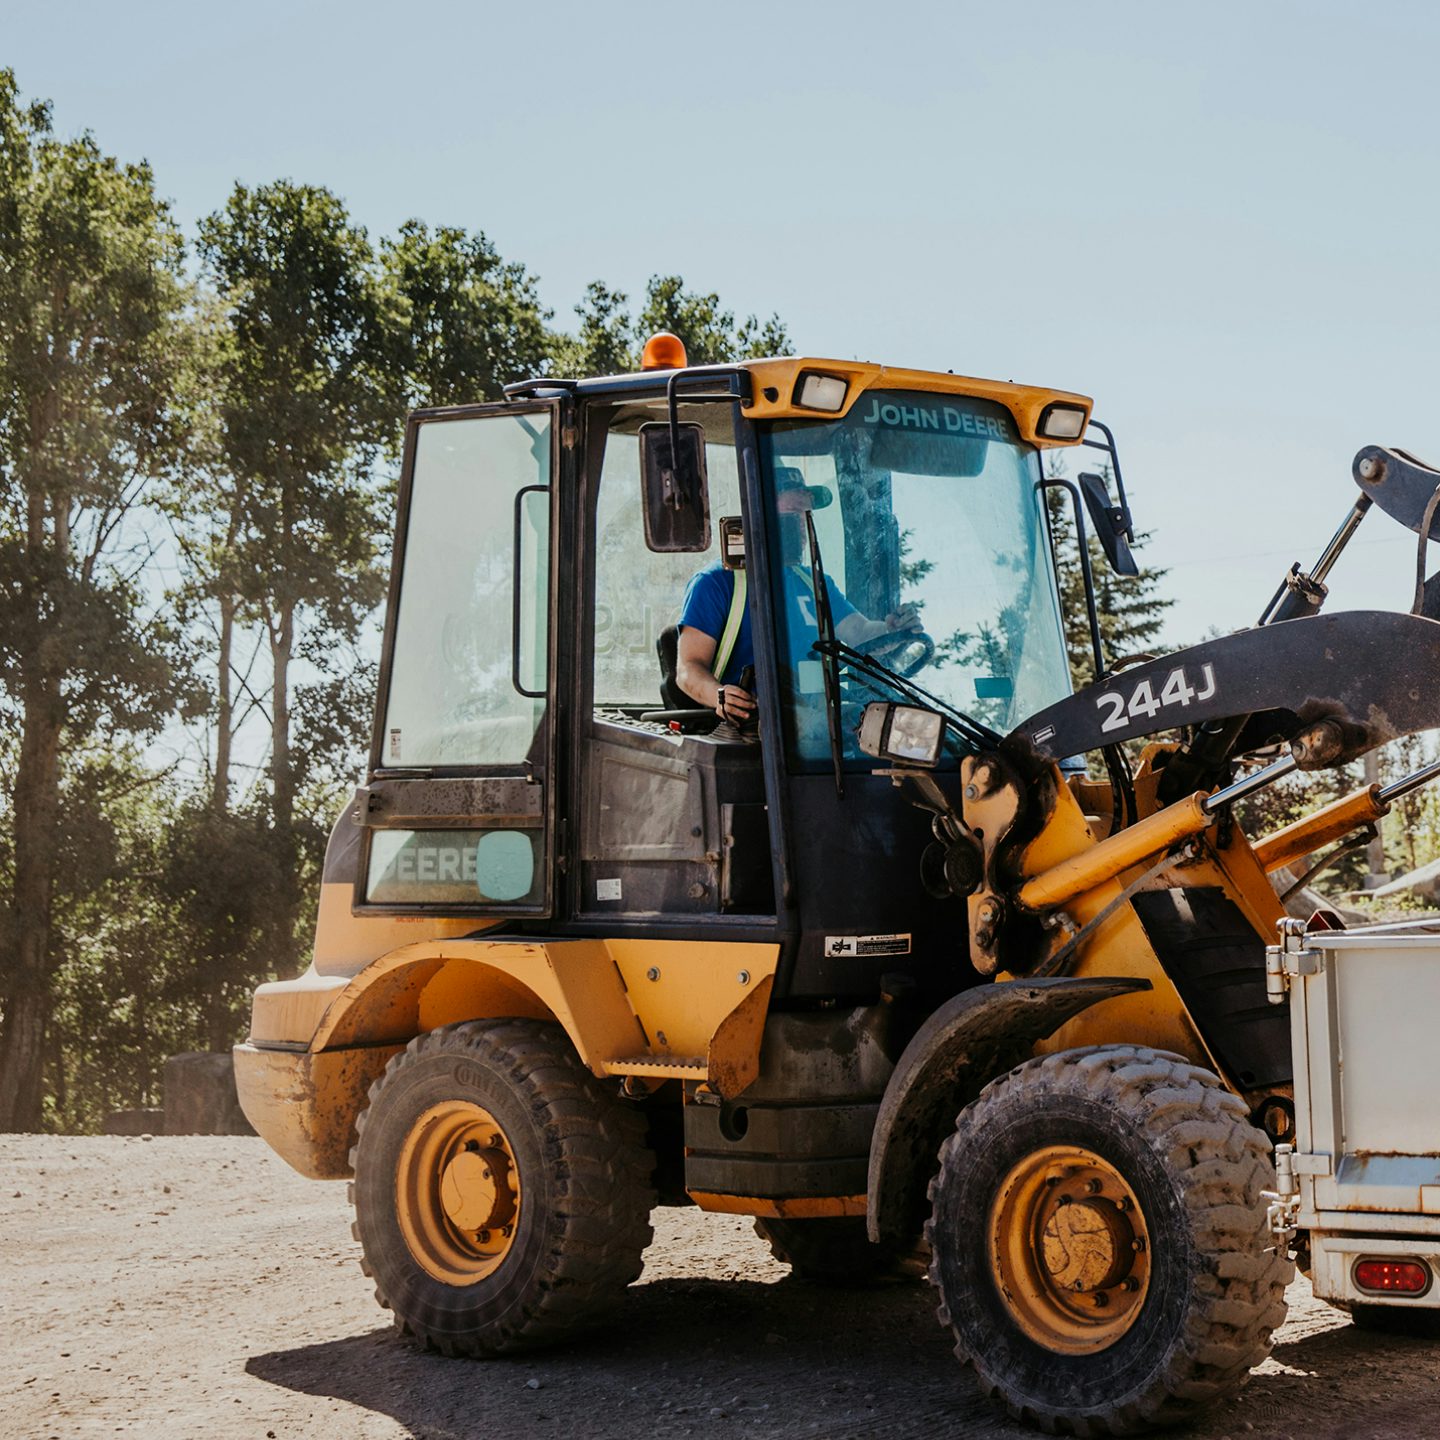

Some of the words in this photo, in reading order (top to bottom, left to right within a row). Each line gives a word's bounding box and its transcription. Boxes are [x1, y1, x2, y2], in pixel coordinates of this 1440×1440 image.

[864, 399, 939, 429] JOHN
[943, 407, 1009, 438] DEERE
[1096, 664, 1216, 733] 244J
